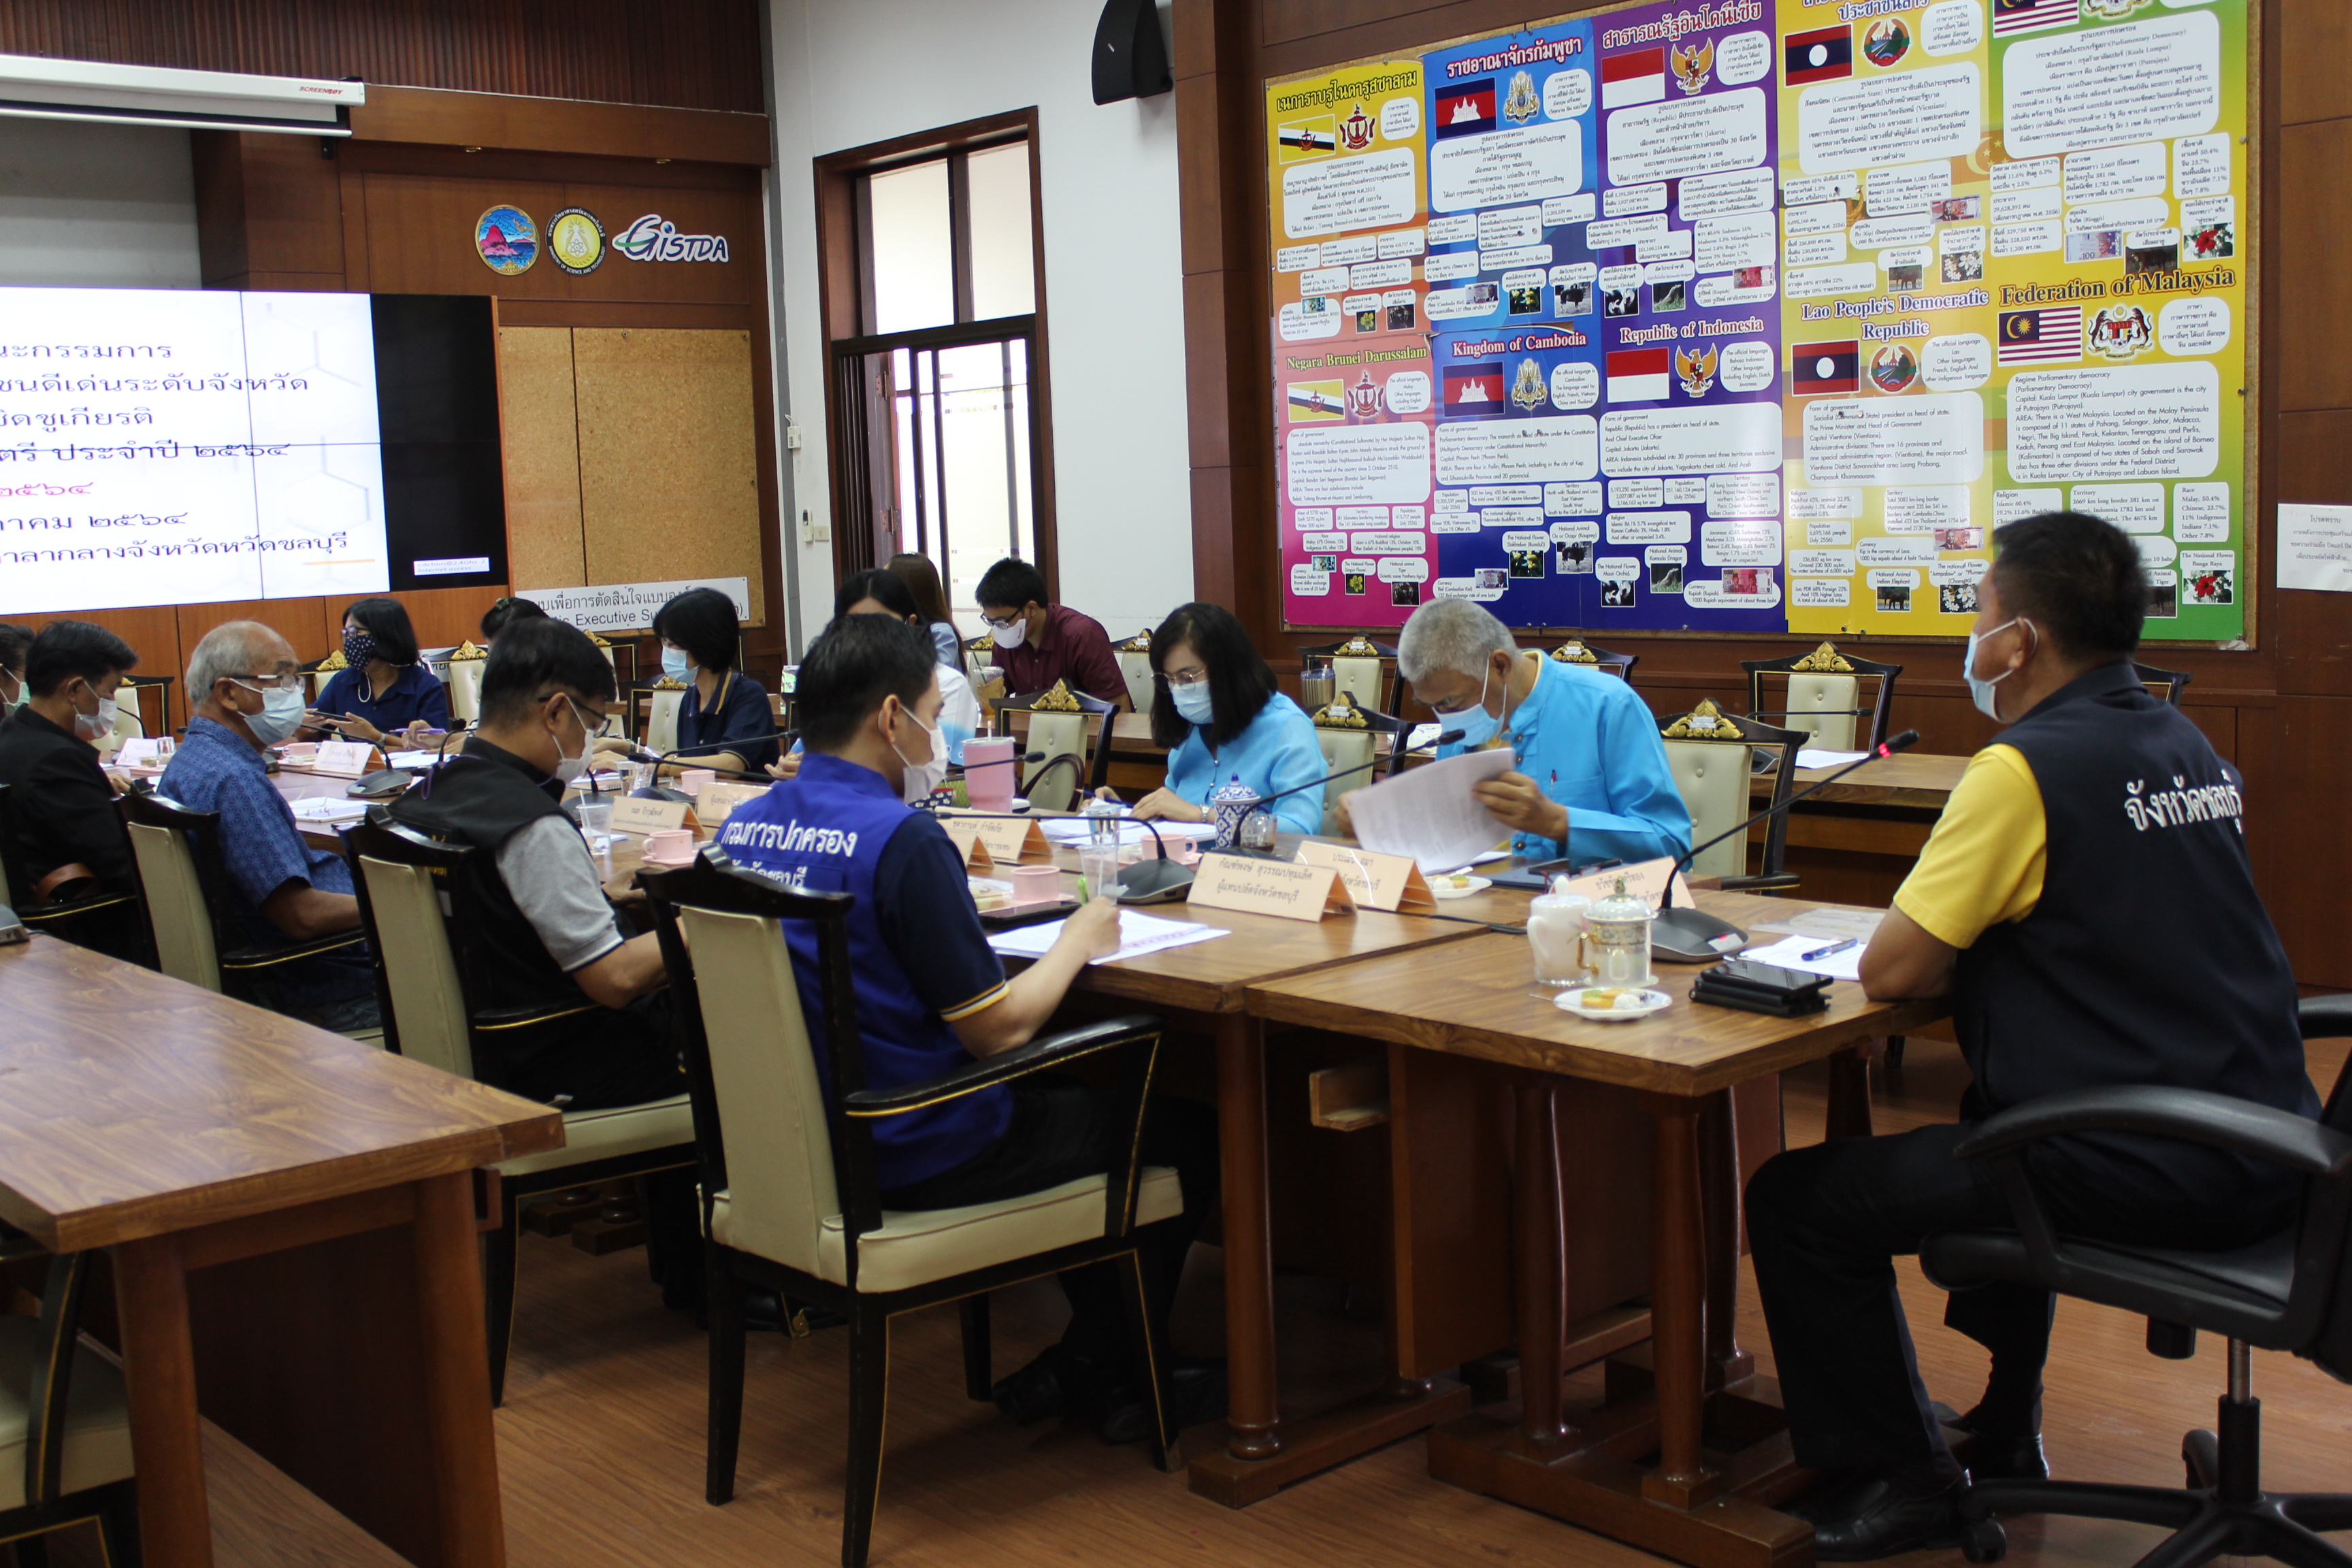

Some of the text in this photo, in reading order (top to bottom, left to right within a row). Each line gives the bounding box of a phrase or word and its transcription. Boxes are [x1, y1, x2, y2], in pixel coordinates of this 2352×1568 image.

[1602, 1, 1762, 50] สาธารณรัฐอินโดนีเซีย
[2080, 25, 2136, 42] รูปแบบการปกครอง
[1447, 35, 1584, 79] ราชอาณาจักรกัมพูชา
[1861, 74, 1912, 90] รูปแบบการปกครอง
[1276, 69, 1418, 113] เนการาบรูไนดารุสซาลาม
[1658, 99, 1706, 114] รูปแบบการปกครอง
[2082, 252, 2095, 260] 100
[566, 267, 583, 275] SCIENCE
[1999, 265, 2235, 306] Federation of Malaysia
[1801, 303, 1830, 321] Lao
[1899, 289, 1989, 315] Democratic
[1620, 316, 1764, 345] Republic of Indonesia
[1861, 318, 1930, 343] Republic
[1452, 331, 1586, 358] Kingdom of Cambodia
[1287, 346, 1428, 372] Negara Brunei Darussalam
[2015, 376, 2036, 385] Regime
[2038, 374, 2077, 382] Parliamentary
[2015, 381, 2092, 393] (Parliamentary Democracy)
[2015, 394, 2038, 404] Capital:
[2039, 393, 2056, 401] Kuala
[2057, 393, 2078, 402] Lumpur
[2080, 391, 2100, 399] (Kuala
[2102, 389, 2125, 399] Lumpur)
[2127, 389, 2138, 397] city
[2140, 387, 2175, 397] government
[2195, 385, 2206, 393] city
[1605, 425, 1623, 434] Republic
[1624, 423, 1646, 432] (Republic)
[1661, 422, 1682, 430] president
[1868, 421, 1882, 429] Head
[1809, 434, 1827, 442] Capital
[1853, 431, 1882, 440] (Vientiane).
[52, 440, 179, 461] ประจำปี
[193, 442, 291, 459] ๒๕๖๔
[2182, 495, 2200, 504] Malay,
[88, 512, 189, 527] ๒๕๖๔
[2196, 514, 2227, 522] Indigenous
[2310, 515, 2341, 523] โปรดทราบ
[0, 532, 348, 564] าลากลางจังหวัดหวัดชลบุรี
[575, 611, 637, 626] Executive
[641, 610, 658, 623] Su
[721, 819, 858, 858] กรมการปกครอง
